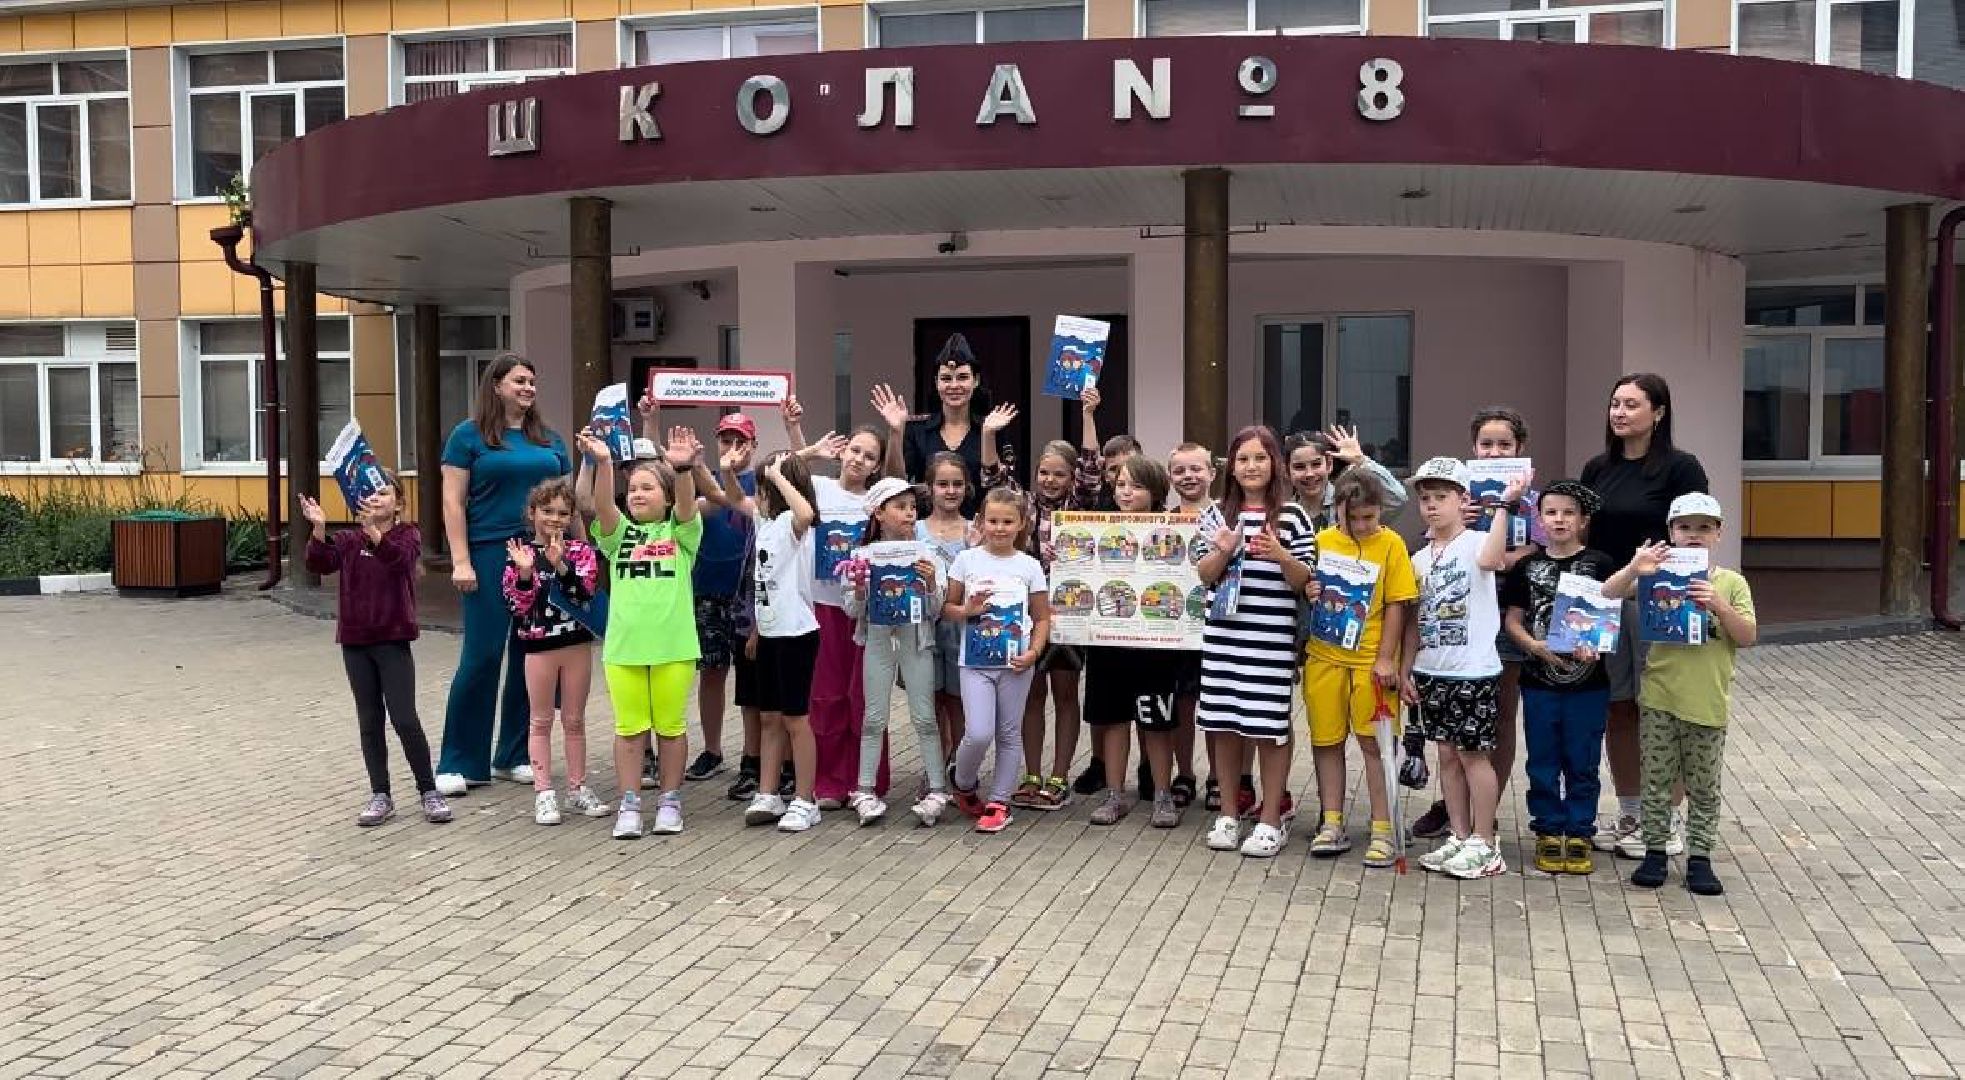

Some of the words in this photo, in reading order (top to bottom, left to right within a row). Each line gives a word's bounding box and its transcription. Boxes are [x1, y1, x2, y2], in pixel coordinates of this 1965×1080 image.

[488, 65, 1037, 157] ШКОЛА
[1357, 57, 1405, 121] 8
[705, 377, 770, 388] безопасное
[664, 388, 720, 400] дорожное
[721, 389, 775, 399] движение
